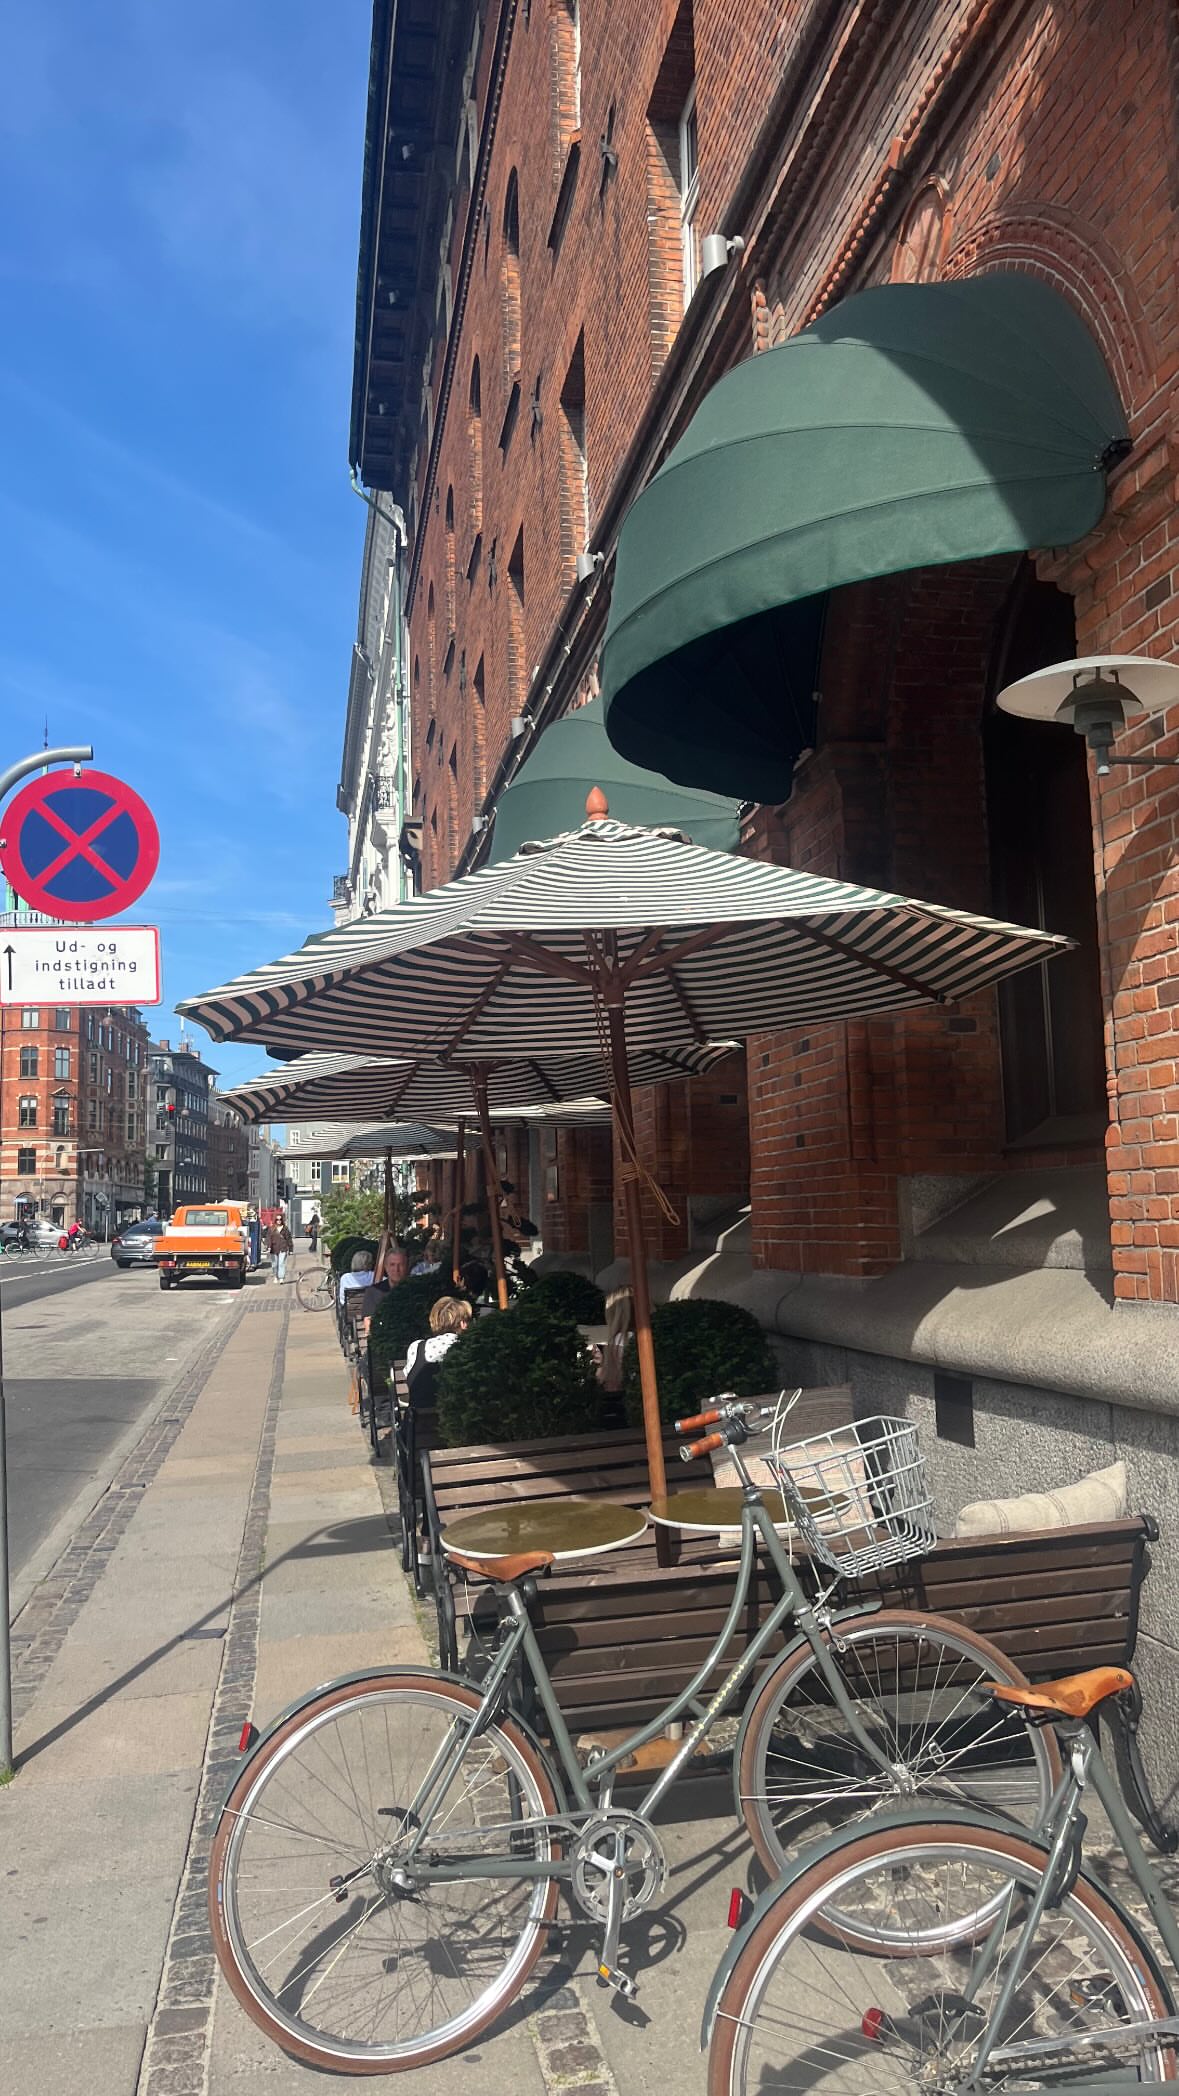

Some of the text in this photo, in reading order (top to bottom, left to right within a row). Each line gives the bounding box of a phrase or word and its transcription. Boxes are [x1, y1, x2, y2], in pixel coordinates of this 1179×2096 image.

[55, 940, 118, 955] Ud- og
[35, 959, 138, 973] indstigning
[58, 977, 116, 990] tilladt
